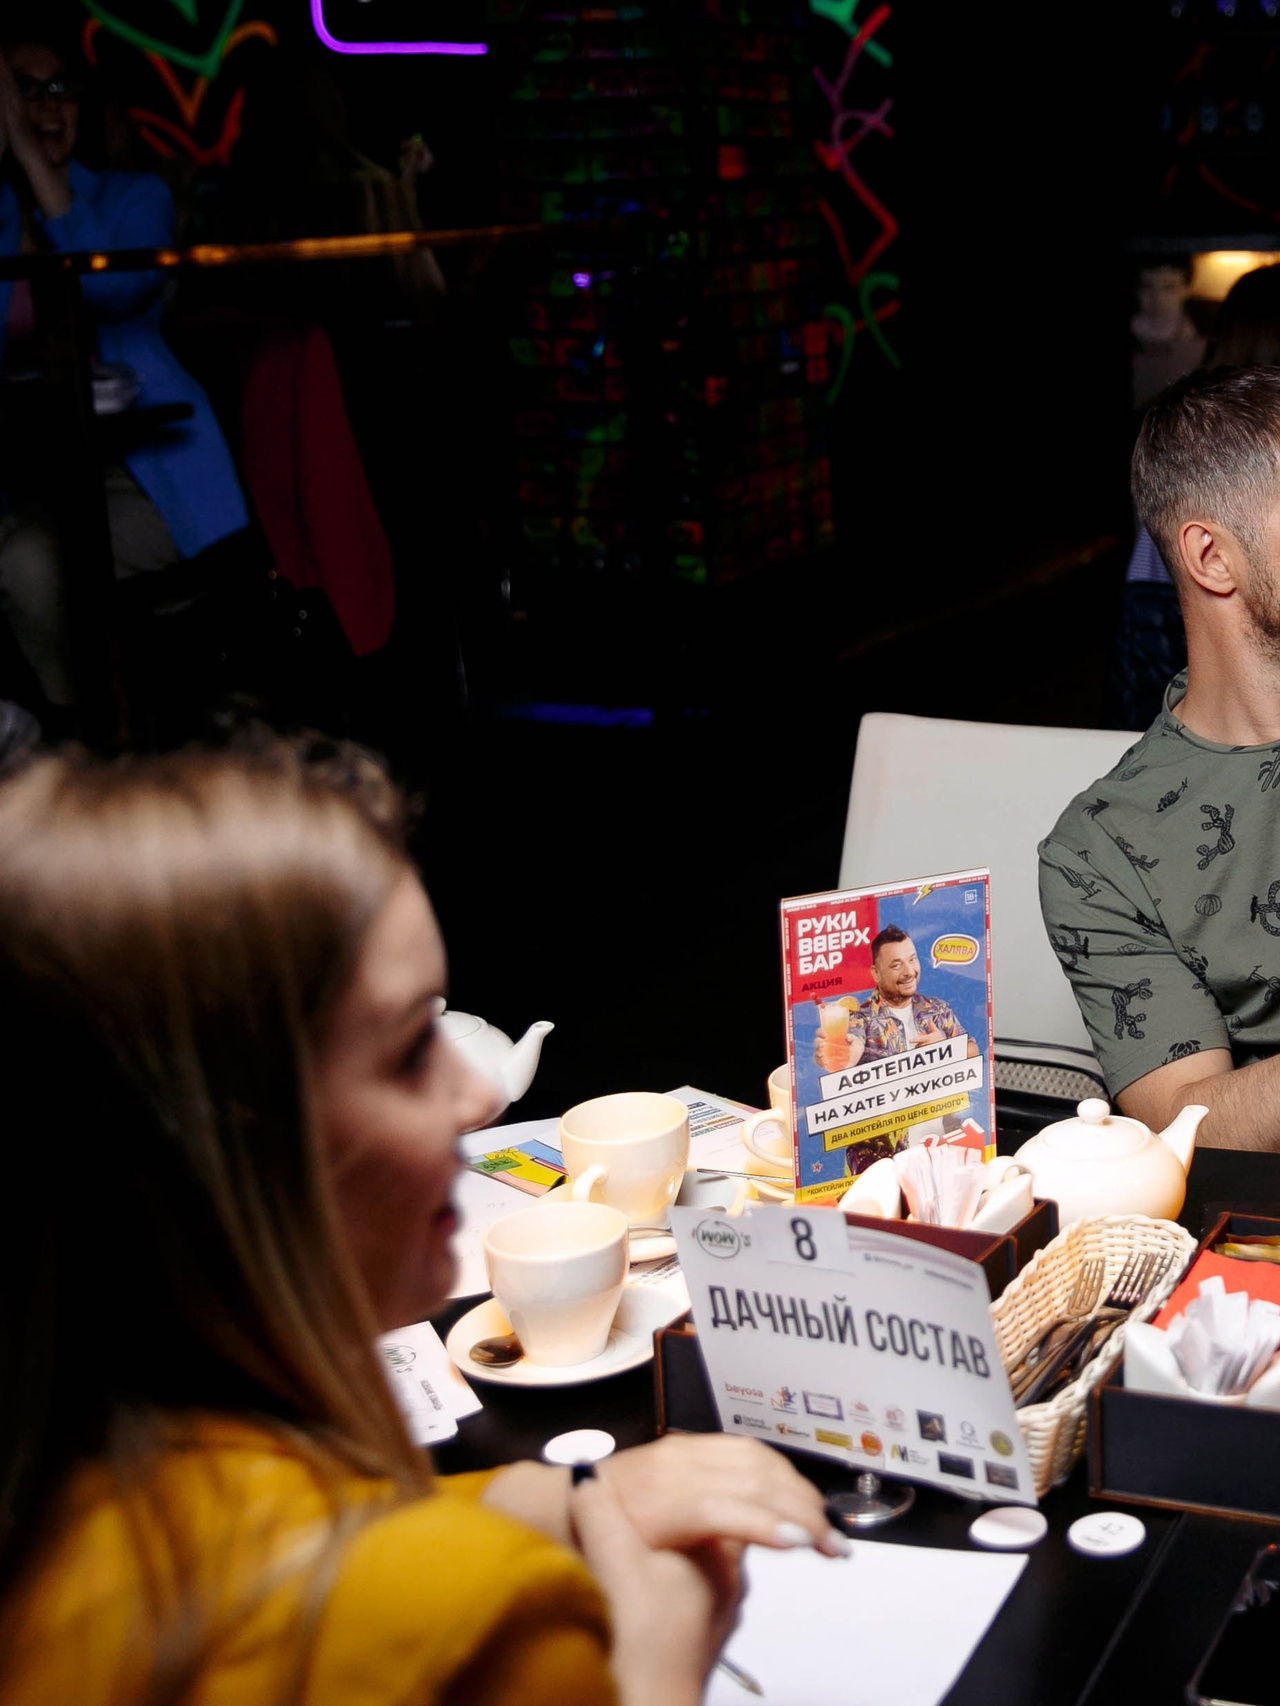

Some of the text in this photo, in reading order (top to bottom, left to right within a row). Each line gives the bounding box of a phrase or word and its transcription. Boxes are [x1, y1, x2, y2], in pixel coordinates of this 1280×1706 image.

[798, 911, 857, 937] РУКИ
[798, 927, 871, 957] ВВЕРХ
[936, 943, 974, 956] ХАЛЯВА
[799, 951, 843, 976] БАР
[802, 977, 843, 992] АКЦИЯ
[838, 1044, 953, 1091] АФТЕПАТИ
[814, 1068, 978, 1125] НА ХАТЕ У ЖУКОВА
[831, 1131, 849, 1145] ДВА
[850, 1118, 894, 1138] КОКТЕЙЛЯ
[895, 1115, 906, 1124] ПО
[908, 1108, 929, 1122] ЦЕНЕ
[789, 1216, 817, 1261] 8
[708, 1285, 991, 1379] ДАЧНЫЙ СОСТАВ
